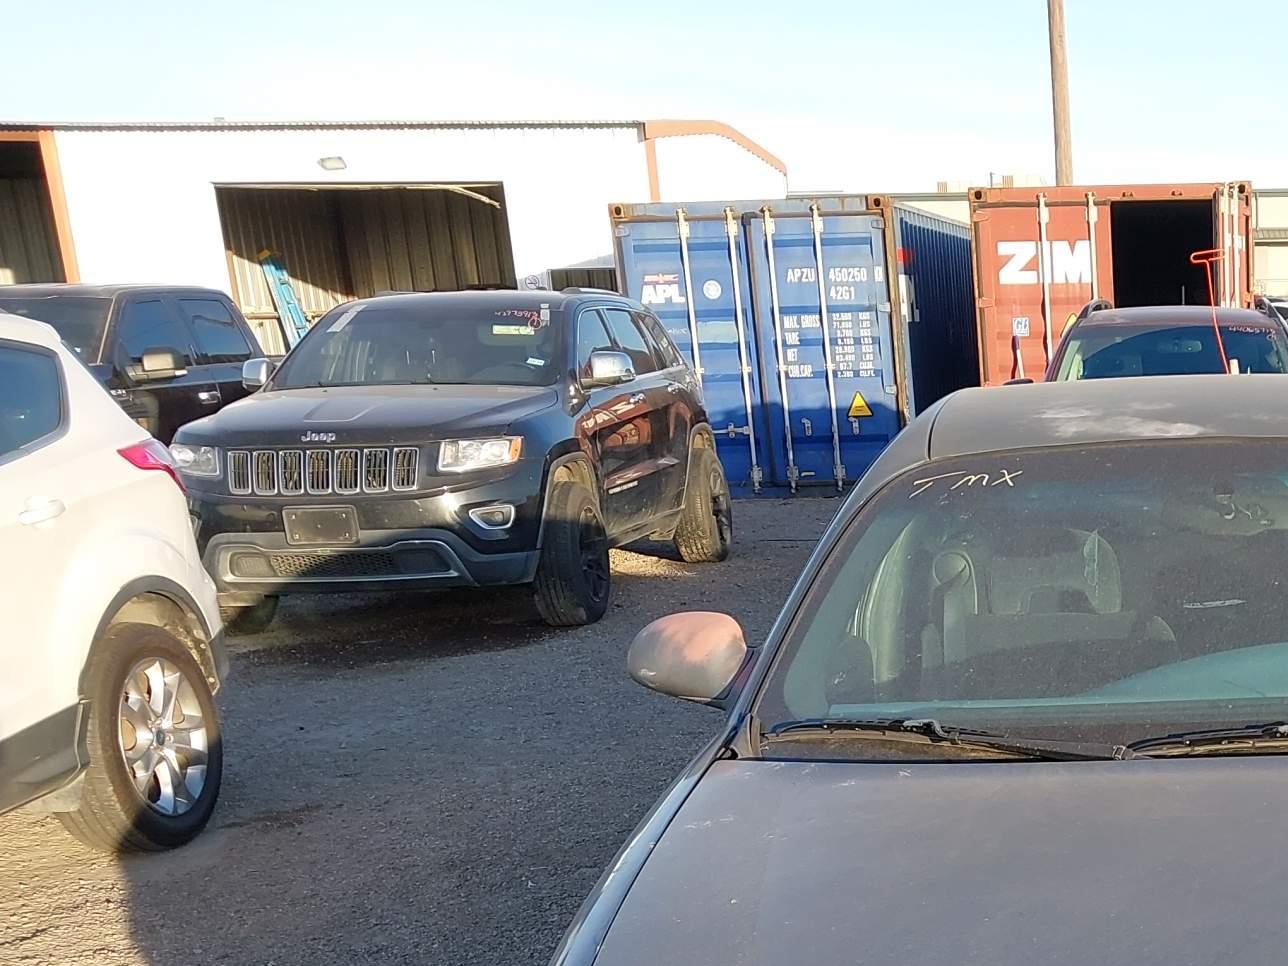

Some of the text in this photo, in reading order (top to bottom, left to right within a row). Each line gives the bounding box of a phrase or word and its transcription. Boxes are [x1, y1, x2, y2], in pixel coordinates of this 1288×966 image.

[787, 268, 815, 283] APZU
[828, 267, 867, 282] 450250
[641, 283, 686, 304] APL
[301, 430, 336, 443] Jeep
